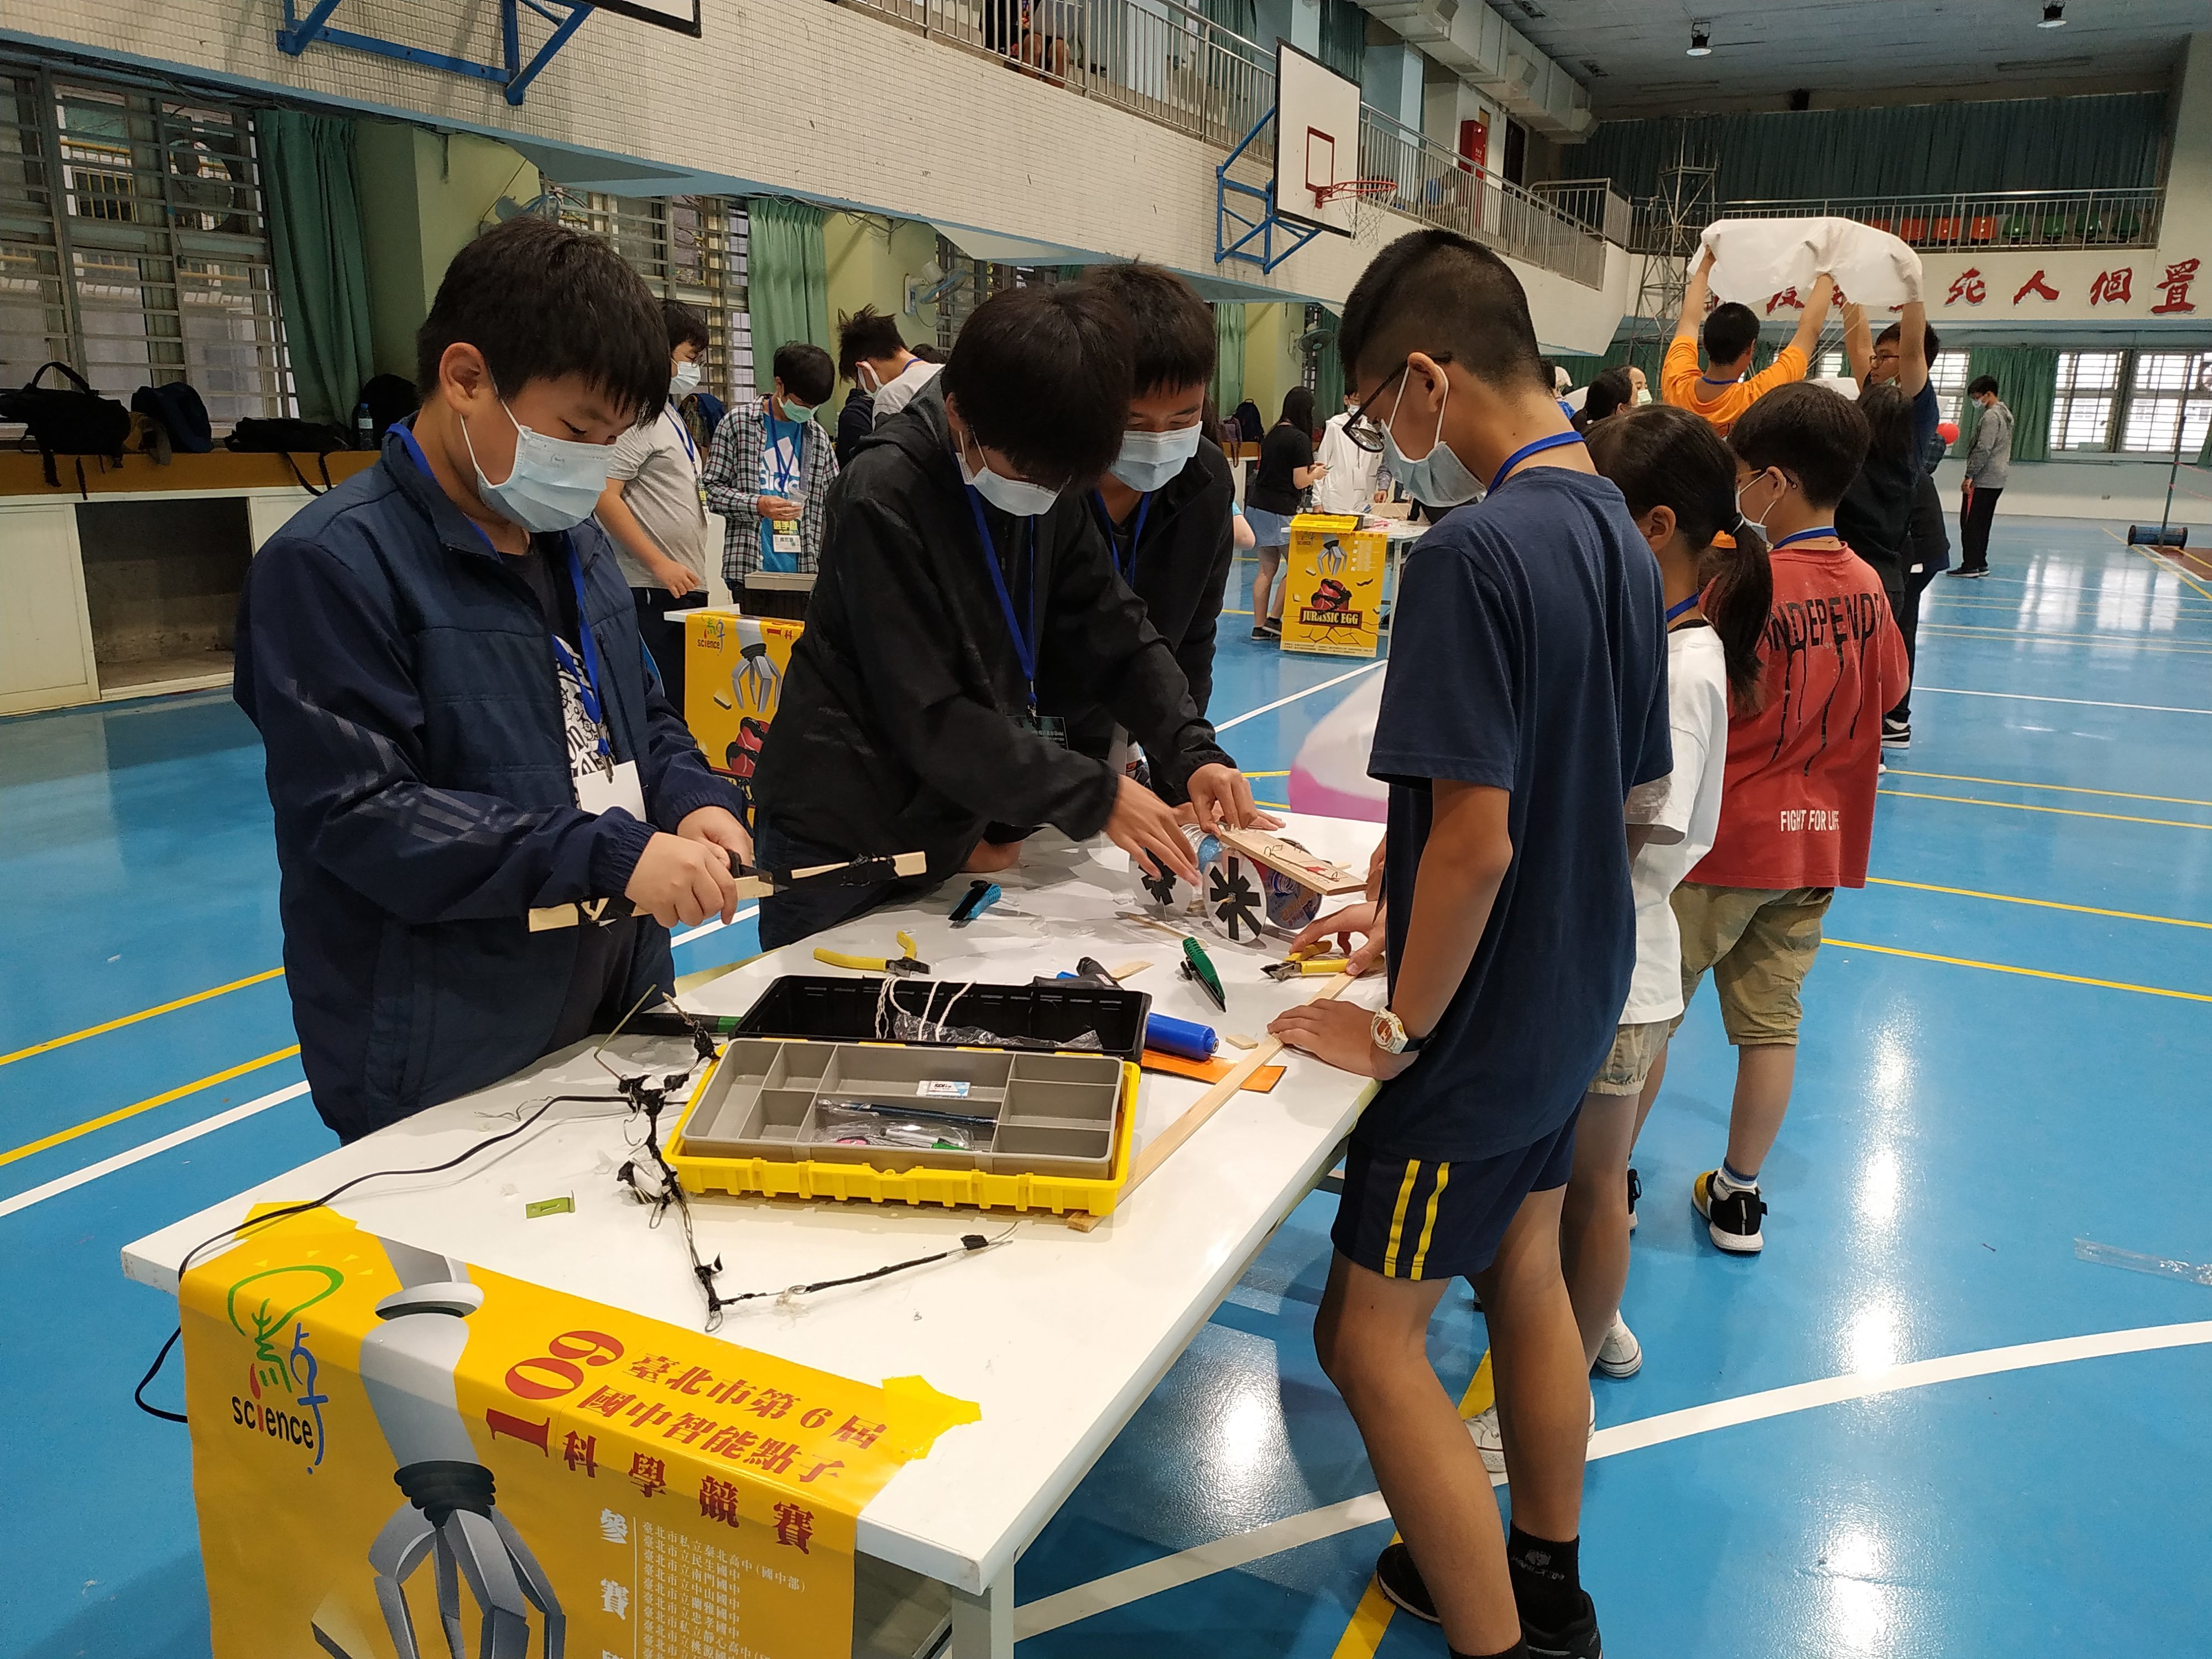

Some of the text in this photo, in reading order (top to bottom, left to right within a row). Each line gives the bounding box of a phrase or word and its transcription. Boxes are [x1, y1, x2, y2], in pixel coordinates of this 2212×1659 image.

[1302, 610, 1359, 624] JURASSIC EGG
[697, 638, 720, 650] science
[1781, 810, 1807, 832] FIGHT
[1808, 810, 1827, 831] FOR
[486, 1330, 624, 1458] 109
[232, 1396, 314, 1449] science
[576, 1384, 846, 1483] 國中智能點子
[563, 1430, 815, 1555] 科學競賽
[643, 1535, 740, 1582] 臺北市立民生國中
[643, 1549, 740, 1596] 臺北市立南門國中
[643, 1563, 740, 1610] 臺北市立中山國中
[643, 1620, 735, 1659] 臺北市立桃源國
